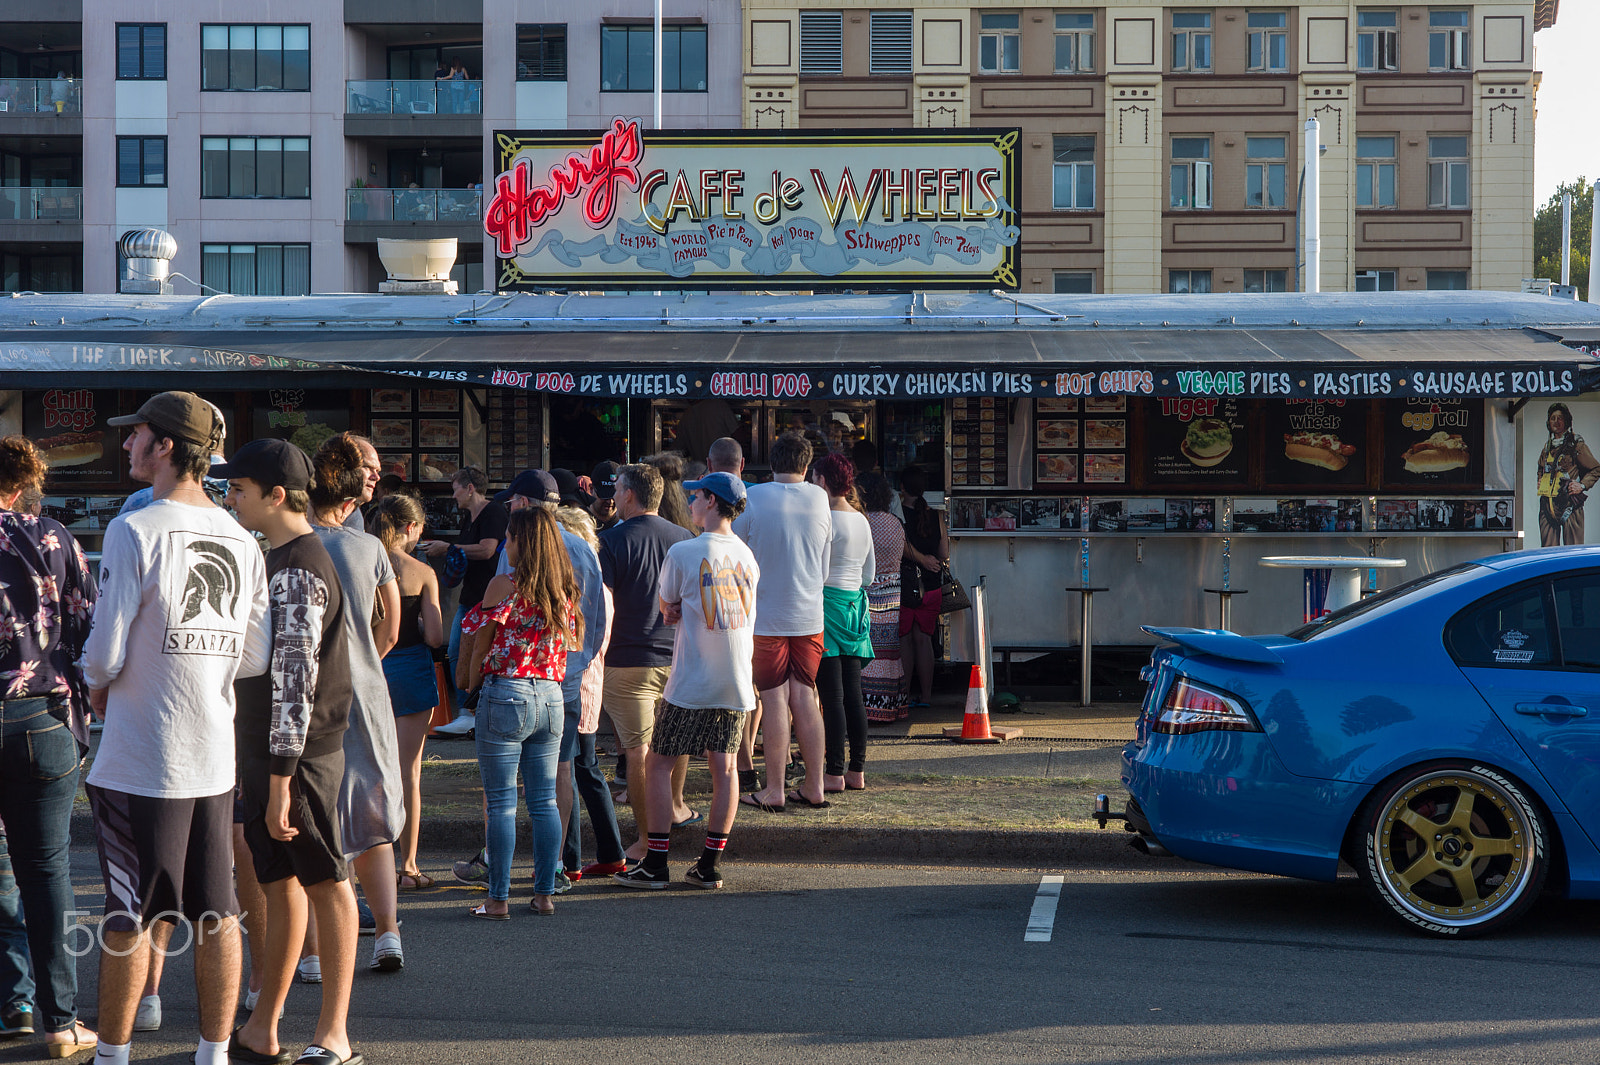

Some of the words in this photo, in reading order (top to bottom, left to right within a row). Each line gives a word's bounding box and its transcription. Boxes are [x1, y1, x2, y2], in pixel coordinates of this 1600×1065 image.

[485, 117, 640, 255] Harry's
[639, 168, 745, 236] CAFE
[753, 169, 804, 225] de
[810, 166, 1000, 230] WHEELS
[671, 234, 706, 246] WORLD
[771, 233, 784, 249] Hot
[788, 226, 815, 242] Dogs
[844, 229, 921, 254] Schweppes
[933, 230, 953, 247] Open
[674, 247, 708, 263] FAMOUS
[491, 370, 532, 388] HOT
[535, 372, 576, 392] DOG
[580, 374, 602, 393] DE
[609, 373, 688, 395] WHEELS
[710, 372, 768, 396] CHILLI
[772, 373, 812, 397] DOG
[832, 373, 900, 395] CURRY
[905, 371, 986, 395] CHICKEN
[992, 371, 1033, 394] PIES
[1055, 372, 1096, 395] HOT
[1099, 370, 1154, 394] CHIPS
[1176, 370, 1246, 395] VEGGIE
[1250, 372, 1292, 394] PIES
[1313, 372, 1392, 395] PASTIES
[1413, 371, 1505, 394] SAUSAGE
[1511, 370, 1574, 393] ROLLS
[42, 388, 94, 410] Chilli
[1157, 396, 1220, 422] Tiger
[1305, 401, 1326, 416] de
[43, 408, 97, 432] Dogs
[1289, 414, 1341, 430] Wheels
[1402, 412, 1435, 431] egg
[1438, 410, 1469, 427] roll
[168, 632, 238, 654] SPARTA
[1470, 765, 1544, 859] UNIVERSAL
[1366, 832, 1460, 935] MOTORSPORTS
